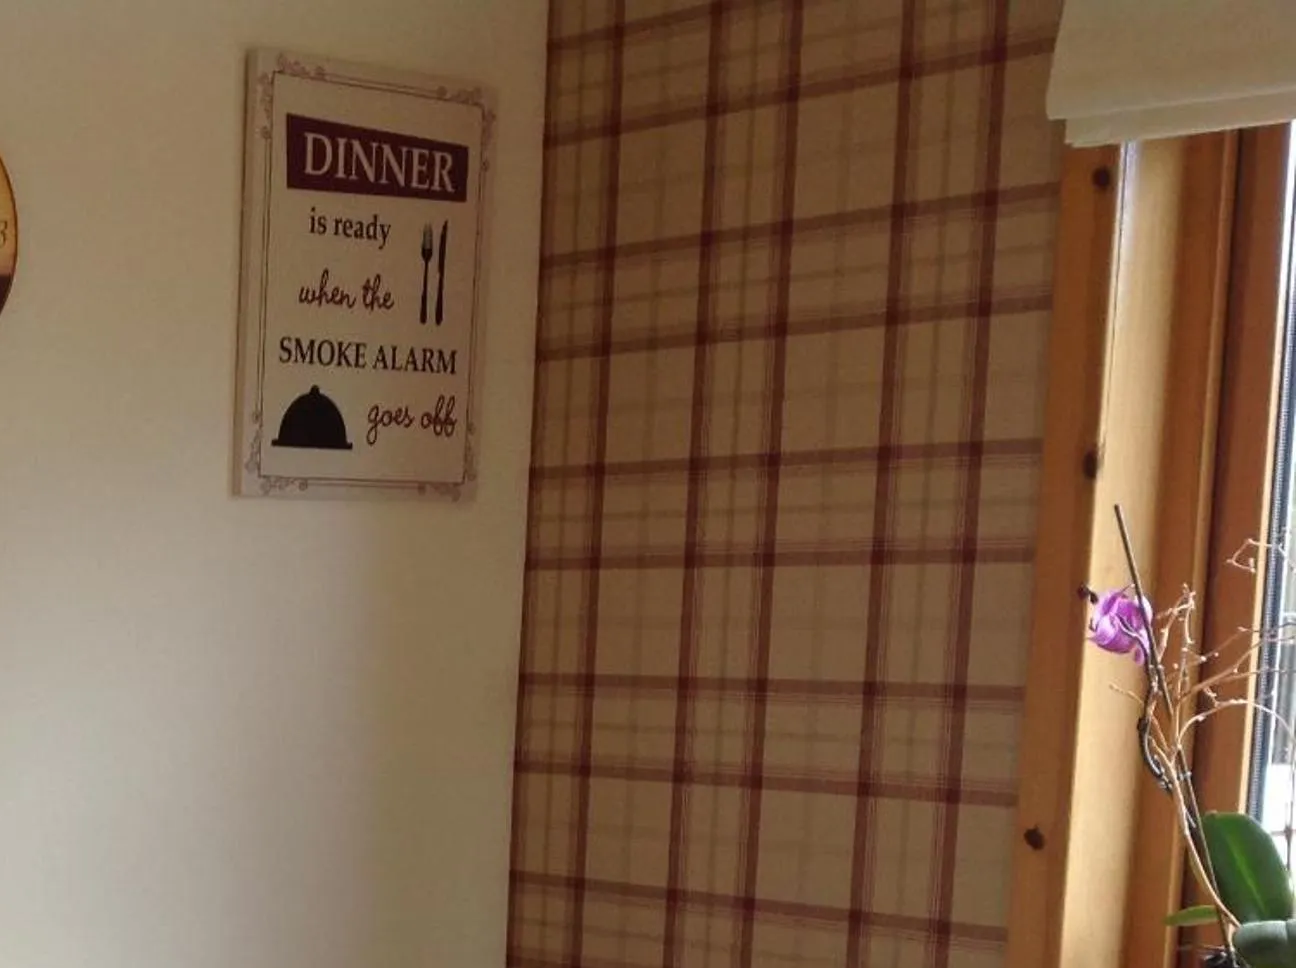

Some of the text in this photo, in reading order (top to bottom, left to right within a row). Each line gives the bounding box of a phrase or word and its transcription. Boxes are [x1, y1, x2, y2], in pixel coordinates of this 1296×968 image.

[304, 132, 456, 192] DINNER
[309, 206, 391, 249] is ready
[298, 268, 394, 311] when the
[279, 336, 457, 375] SMOKE ALARM
[367, 395, 458, 446] goes off
